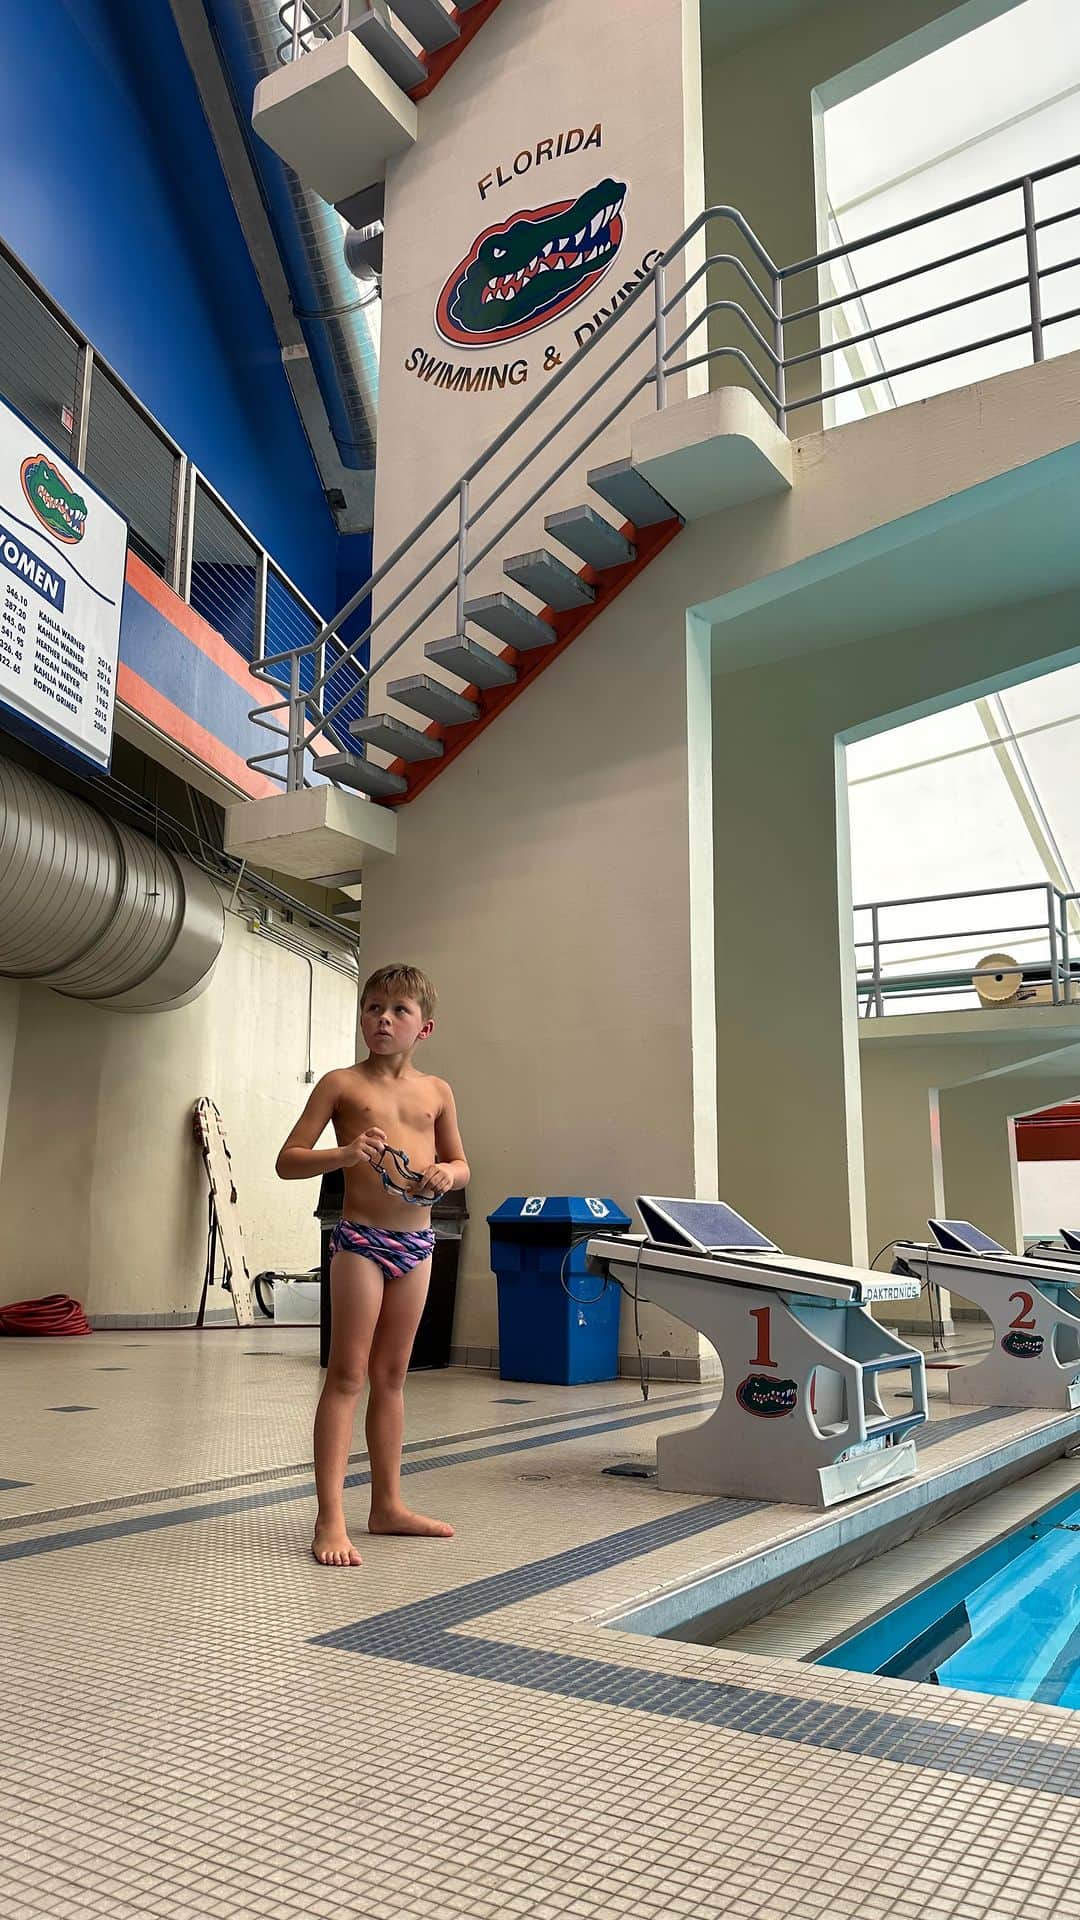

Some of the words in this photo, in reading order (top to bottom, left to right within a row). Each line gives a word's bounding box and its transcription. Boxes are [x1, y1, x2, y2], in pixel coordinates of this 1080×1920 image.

[478, 123, 602, 200] FLORIDA
[404, 347, 528, 392] SWIMMING
[543, 345, 563, 371] &
[0, 534, 59, 600] OMEN
[1, 625, 24, 648] 541.95
[35, 650, 60, 673] MEGAN
[2, 612, 26, 635] 445.00
[36, 636, 60, 660] HEATHER
[61, 656, 88, 681] LAWRENCE
[4, 598, 27, 620] 387.20
[60, 640, 84, 665] WARNER
[96, 669, 111, 685] 2016
[6, 584, 28, 607] 346.10
[61, 627, 85, 653] WARNER
[97, 656, 112, 673] 2016
[33, 677, 55, 698] ROBYN
[55, 693, 78, 714] GRIMES
[58, 680, 83, 704] WARNER
[866, 1286, 917, 1300] DAKTRONICS
[1008, 1291, 1036, 1330] 2
[748, 1306, 778, 1368] 1
